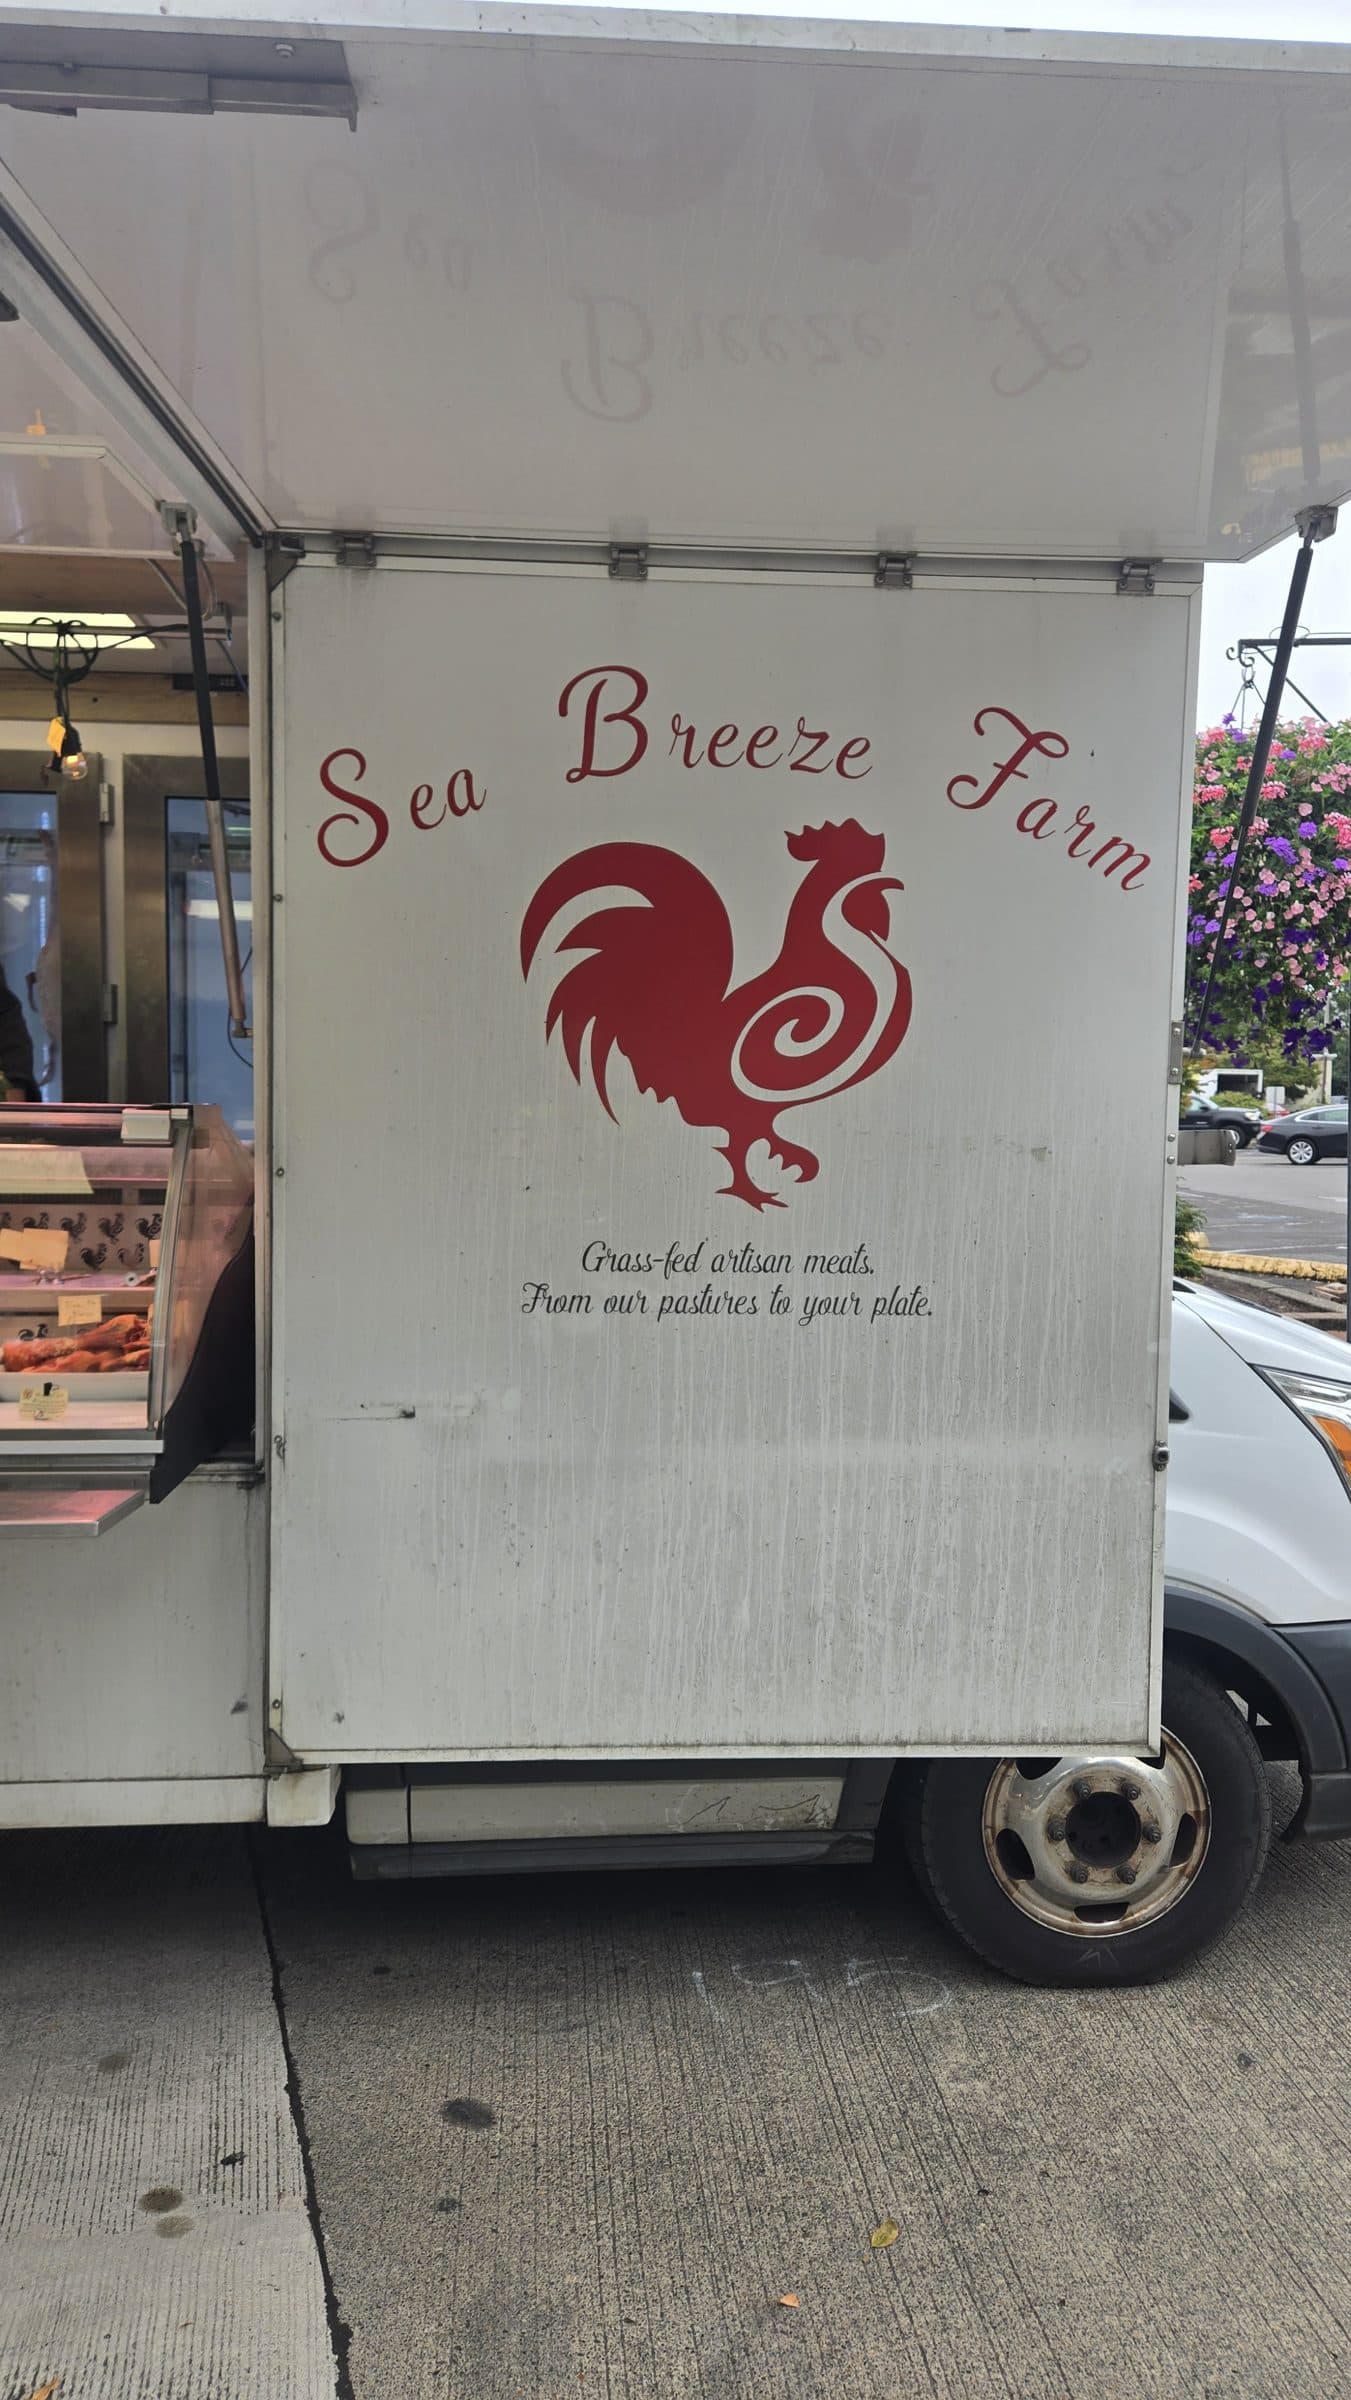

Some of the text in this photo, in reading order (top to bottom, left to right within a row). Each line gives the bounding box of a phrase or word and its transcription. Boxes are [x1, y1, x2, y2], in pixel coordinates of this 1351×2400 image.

[317, 665, 1152, 892] Sea Breeze Farm
[581, 1240, 875, 1280] Grass-fed artisan meats.
[520, 1281, 933, 1328] From our pastures to your plate.
